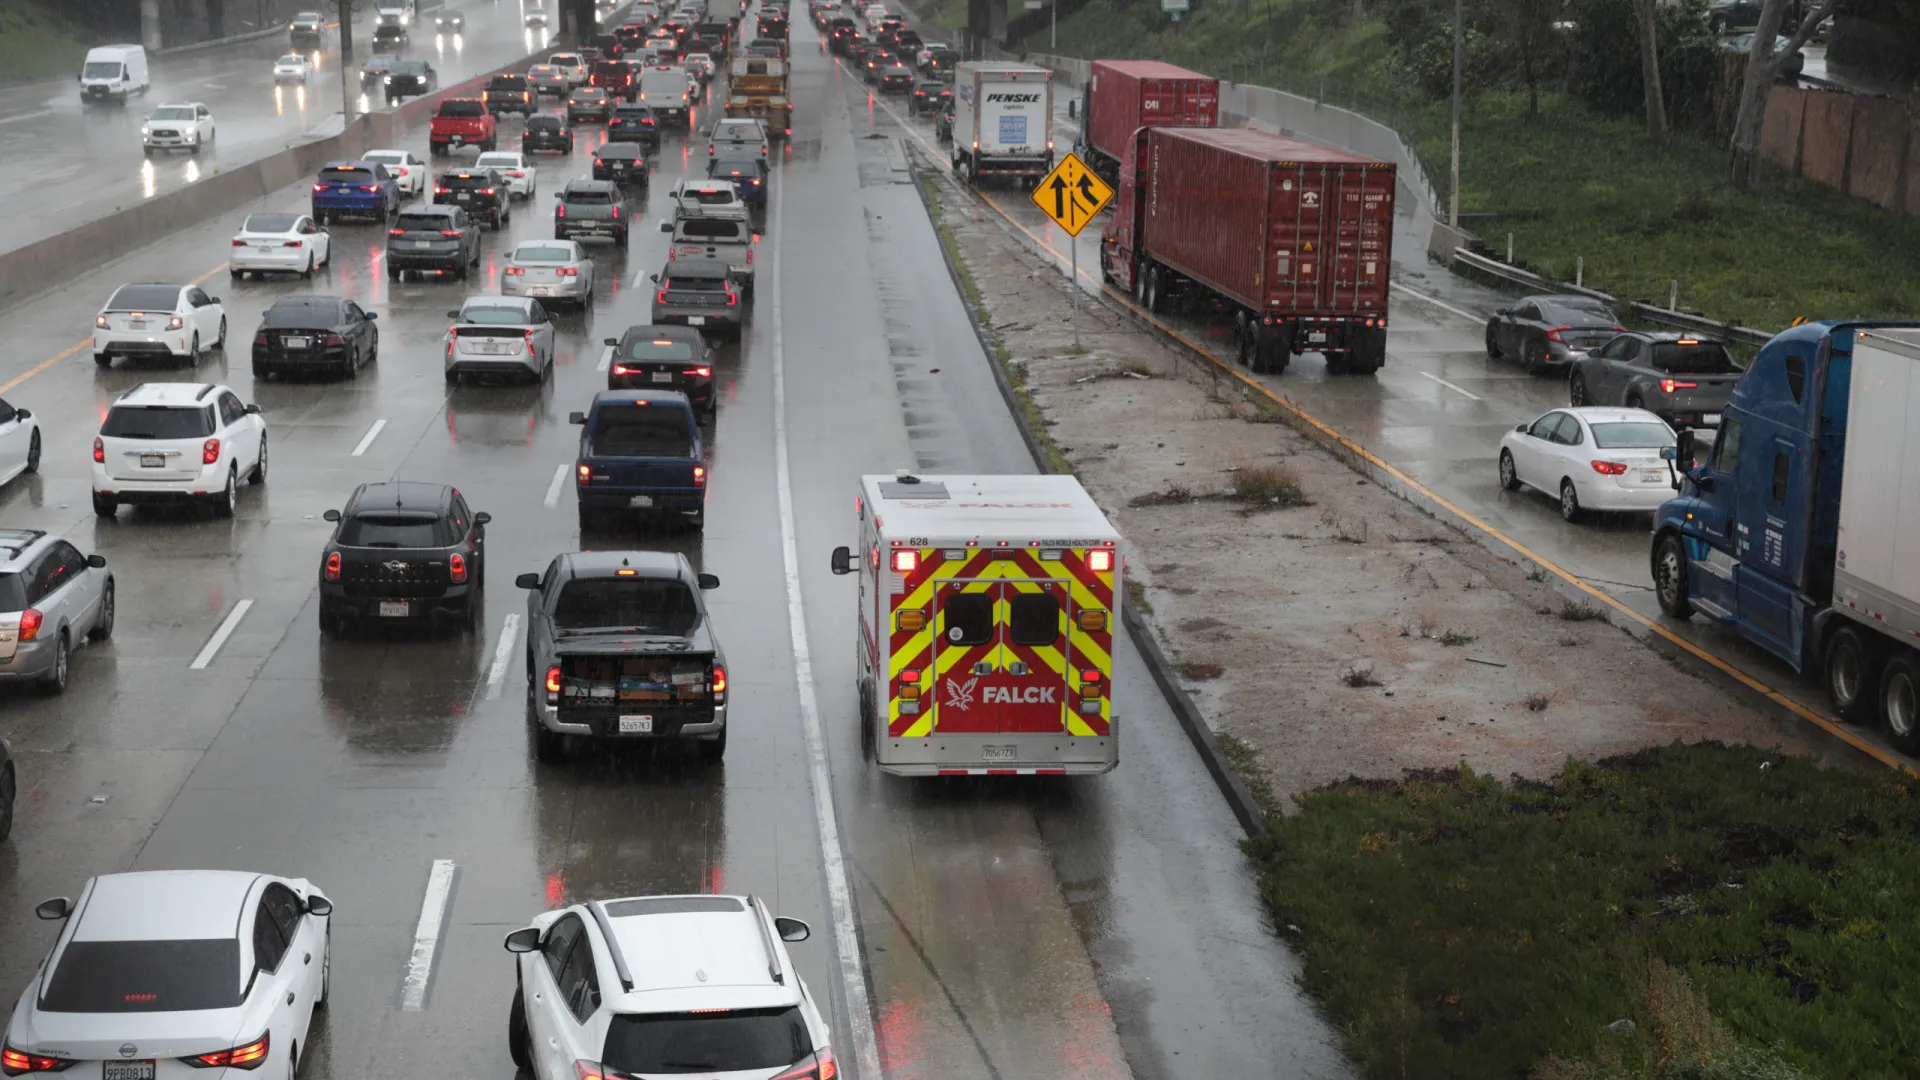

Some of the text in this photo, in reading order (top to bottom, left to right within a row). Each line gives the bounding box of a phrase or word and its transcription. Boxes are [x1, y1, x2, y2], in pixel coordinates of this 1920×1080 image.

[986, 93, 1042, 103] PENSKE
[910, 538, 928, 546] 628
[1056, 539, 1071, 547] MOBILE
[1072, 539, 1089, 547] HEALTH
[983, 687, 1056, 703] FALCK
[107, 1068, 152, 1080] 9PBD813
